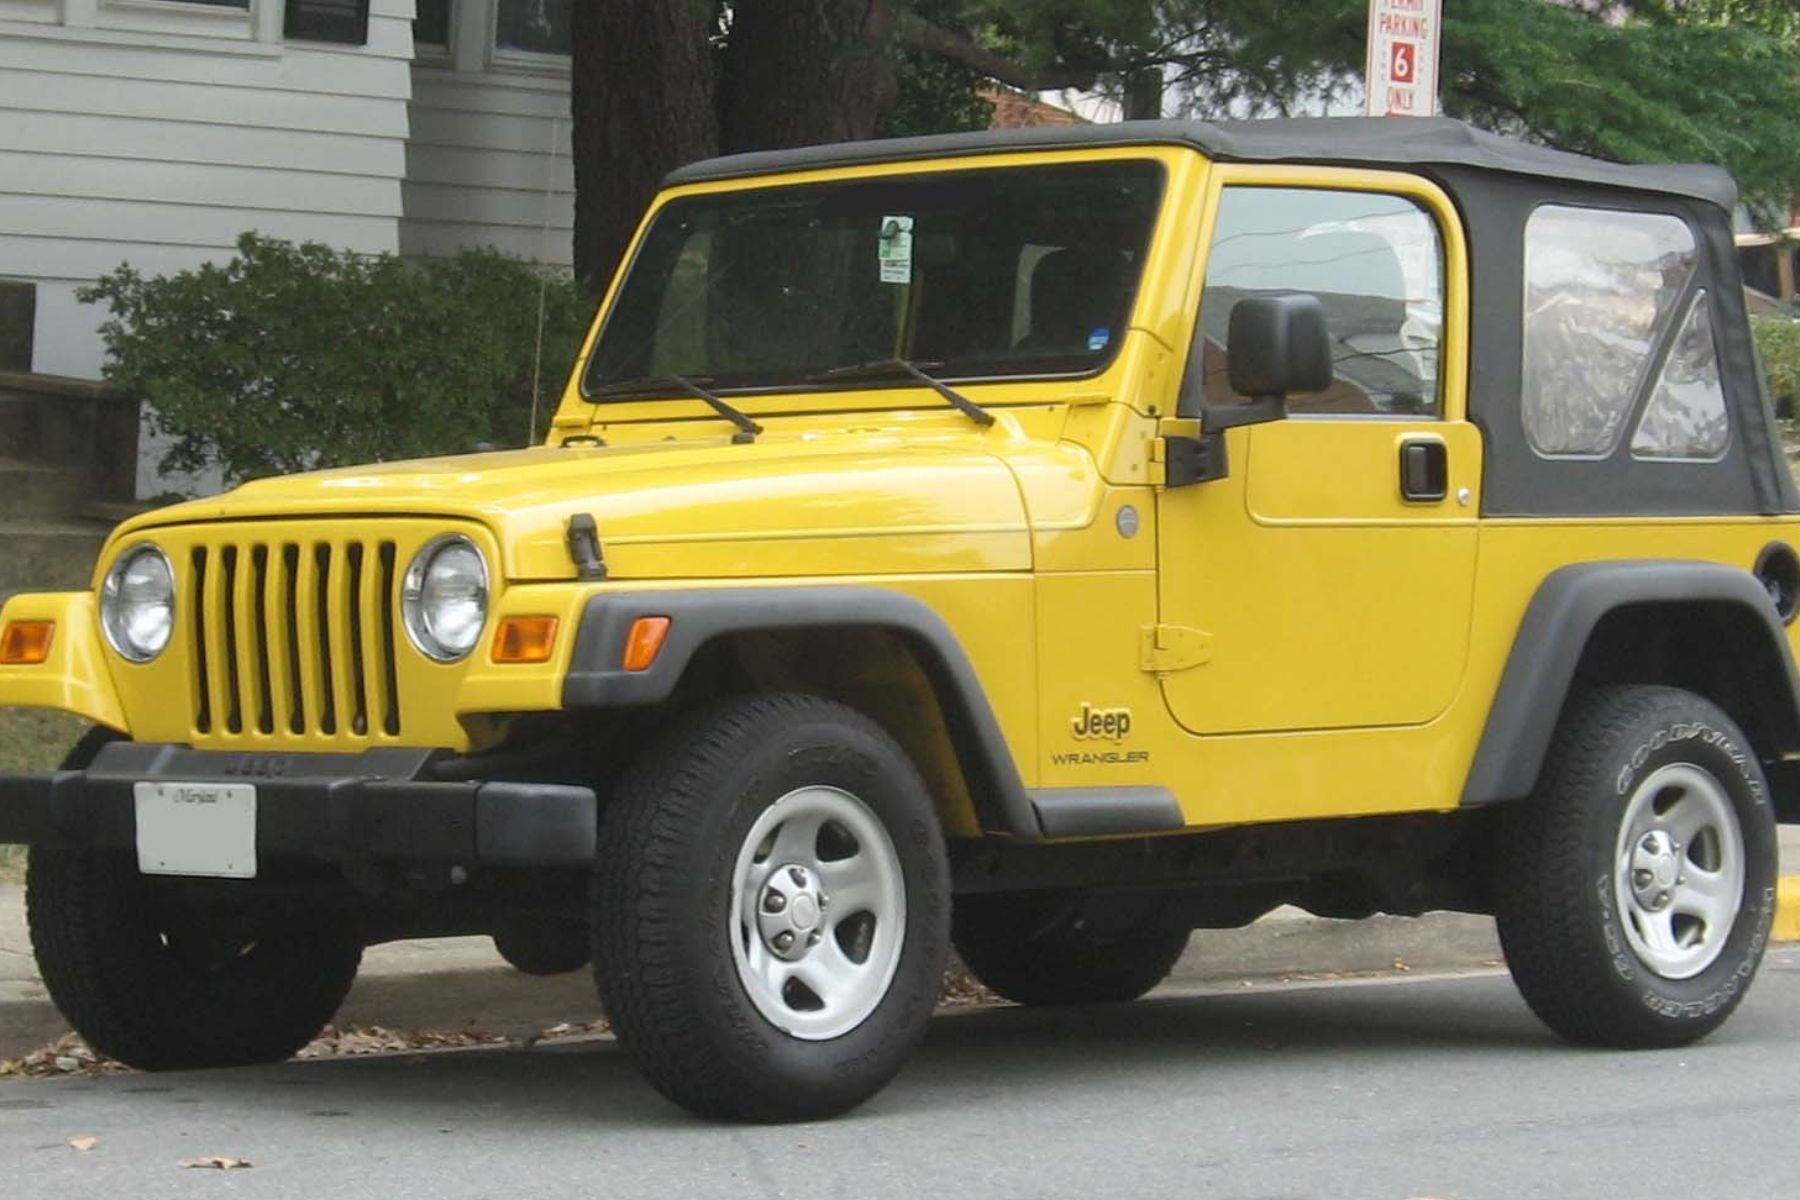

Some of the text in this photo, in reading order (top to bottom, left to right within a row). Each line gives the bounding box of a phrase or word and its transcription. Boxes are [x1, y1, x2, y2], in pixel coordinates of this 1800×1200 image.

[1380, 12, 1427, 39] PARKING
[1394, 47, 1408, 77] 6
[1386, 86, 1415, 110] ONLY
[1073, 705, 1131, 740] Jeep
[1051, 751, 1150, 765] WRANGLER
